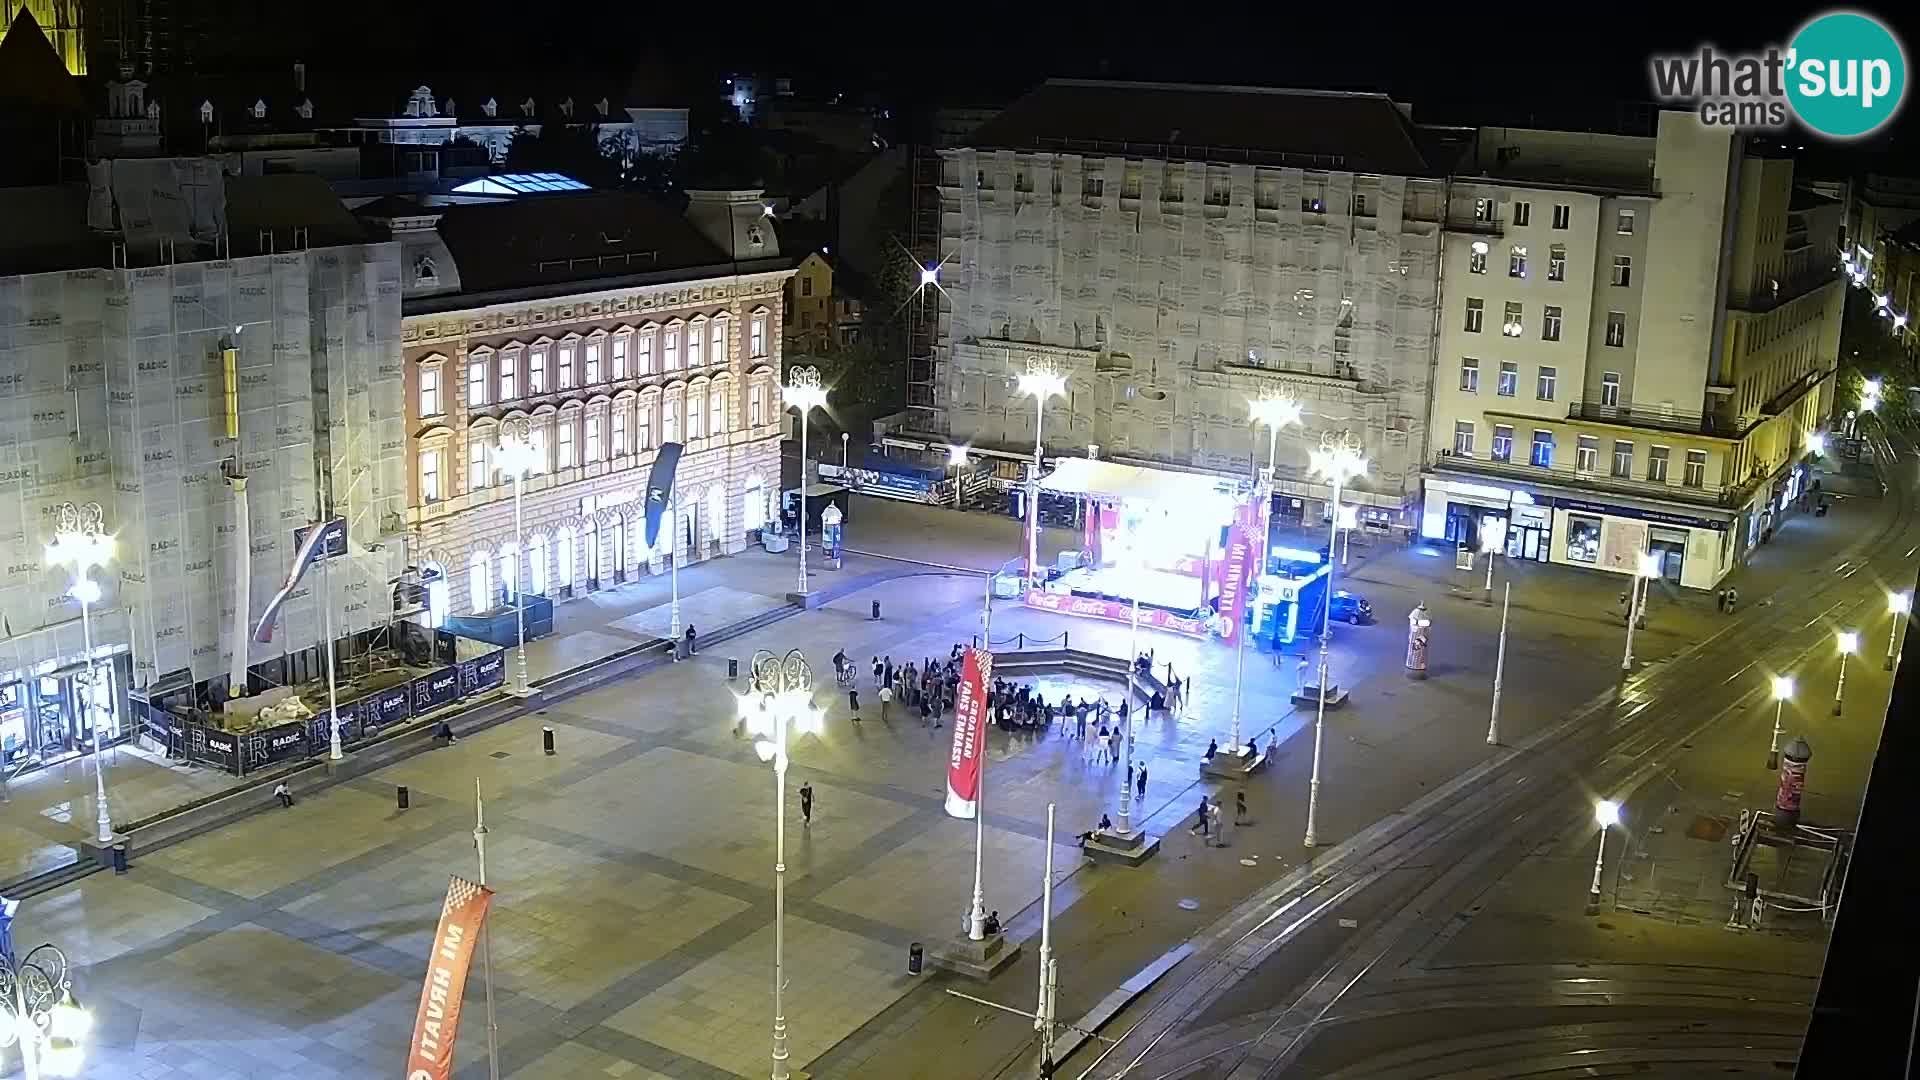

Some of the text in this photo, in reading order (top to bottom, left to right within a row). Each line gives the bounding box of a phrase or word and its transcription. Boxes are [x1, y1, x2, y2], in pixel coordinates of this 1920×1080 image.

[1219, 543, 1248, 611] MI HRVATI
[952, 680, 973, 770] FANS EMBASSY
[963, 700, 979, 759] CROATIAN
